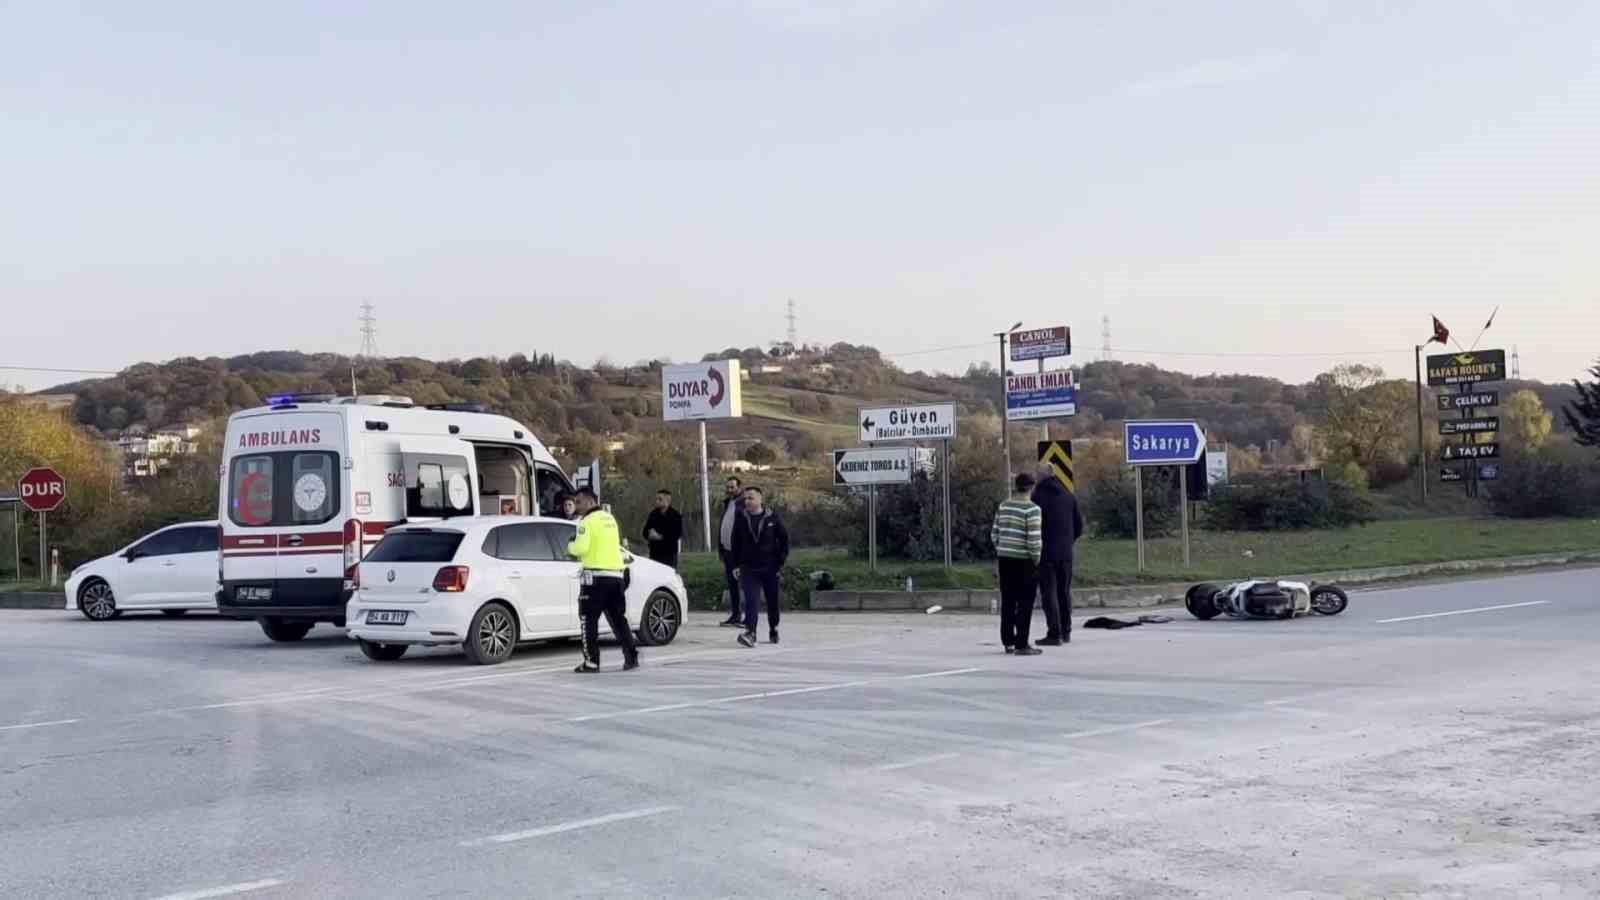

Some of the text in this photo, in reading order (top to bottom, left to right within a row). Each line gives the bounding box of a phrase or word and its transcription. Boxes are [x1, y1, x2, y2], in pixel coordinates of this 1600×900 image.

[1040, 372, 1071, 388] EMLAK
[669, 380, 709, 399] DUYAR
[669, 400, 691, 409] POMPA
[1480, 395, 1493, 405] EV
[889, 408, 936, 425] Güven
[239, 428, 320, 448] AMBULANS
[1132, 433, 1190, 454] Sakarya
[1459, 446, 1494, 457] TAŞ EV
[870, 460, 893, 471] TOROS
[22, 482, 62, 497] DUR
